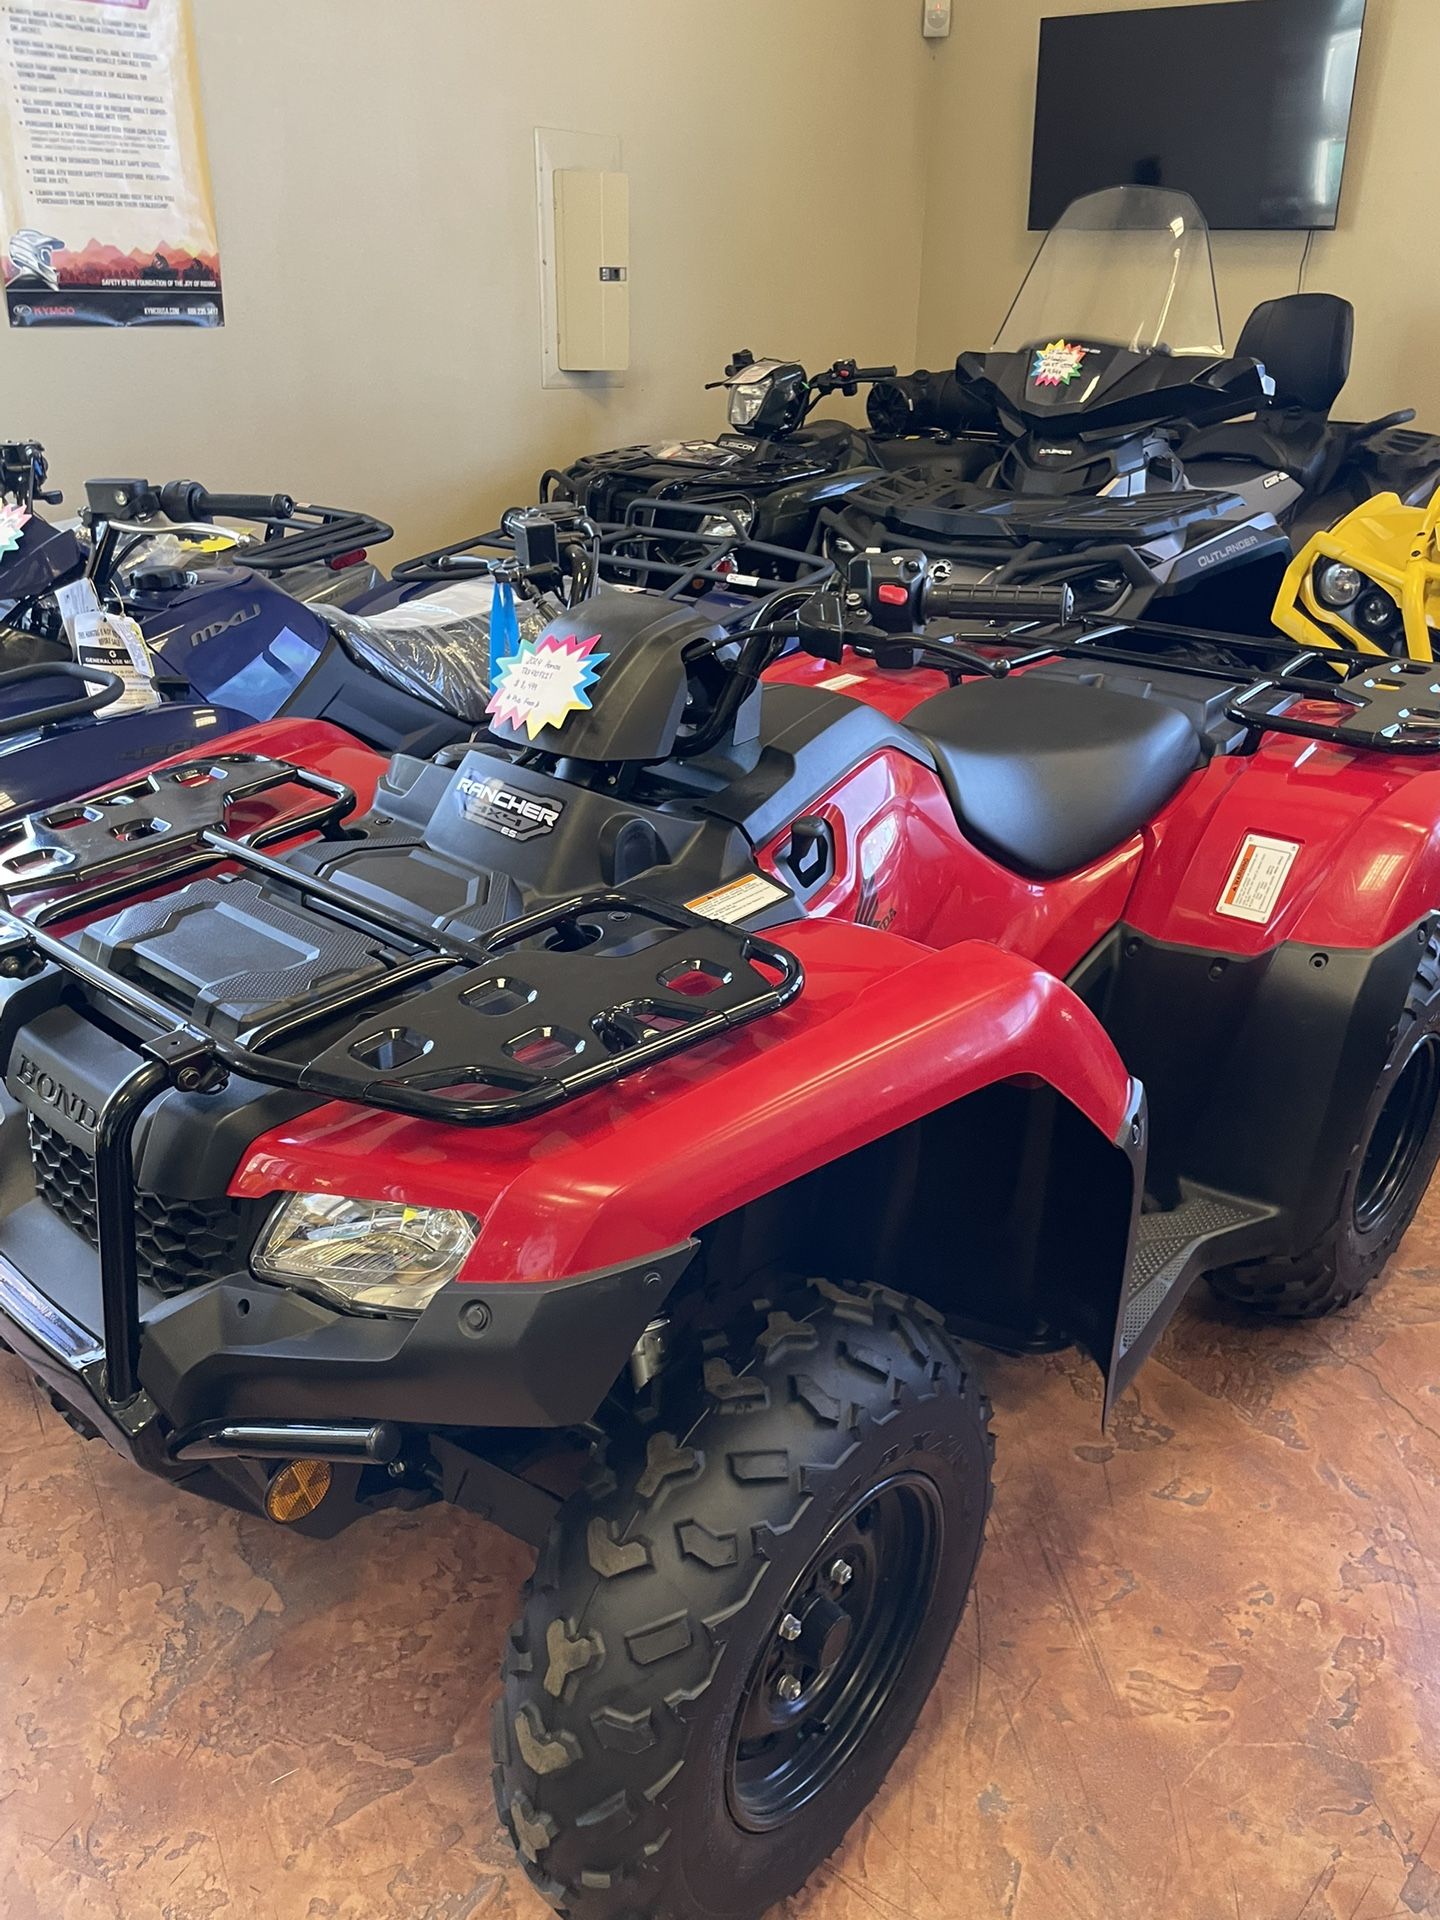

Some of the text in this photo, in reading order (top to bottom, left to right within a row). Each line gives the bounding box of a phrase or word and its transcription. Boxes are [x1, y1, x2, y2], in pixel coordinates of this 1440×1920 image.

[32, 306, 76, 316] KYMCO
[1197, 535, 1258, 568] OUTLANDER
[190, 603, 261, 647] MXU
[109, 650, 117, 658] G
[456, 777, 560, 826] RANCHER
[500, 826, 518, 838] ES
[16, 1054, 98, 1133] HOND
